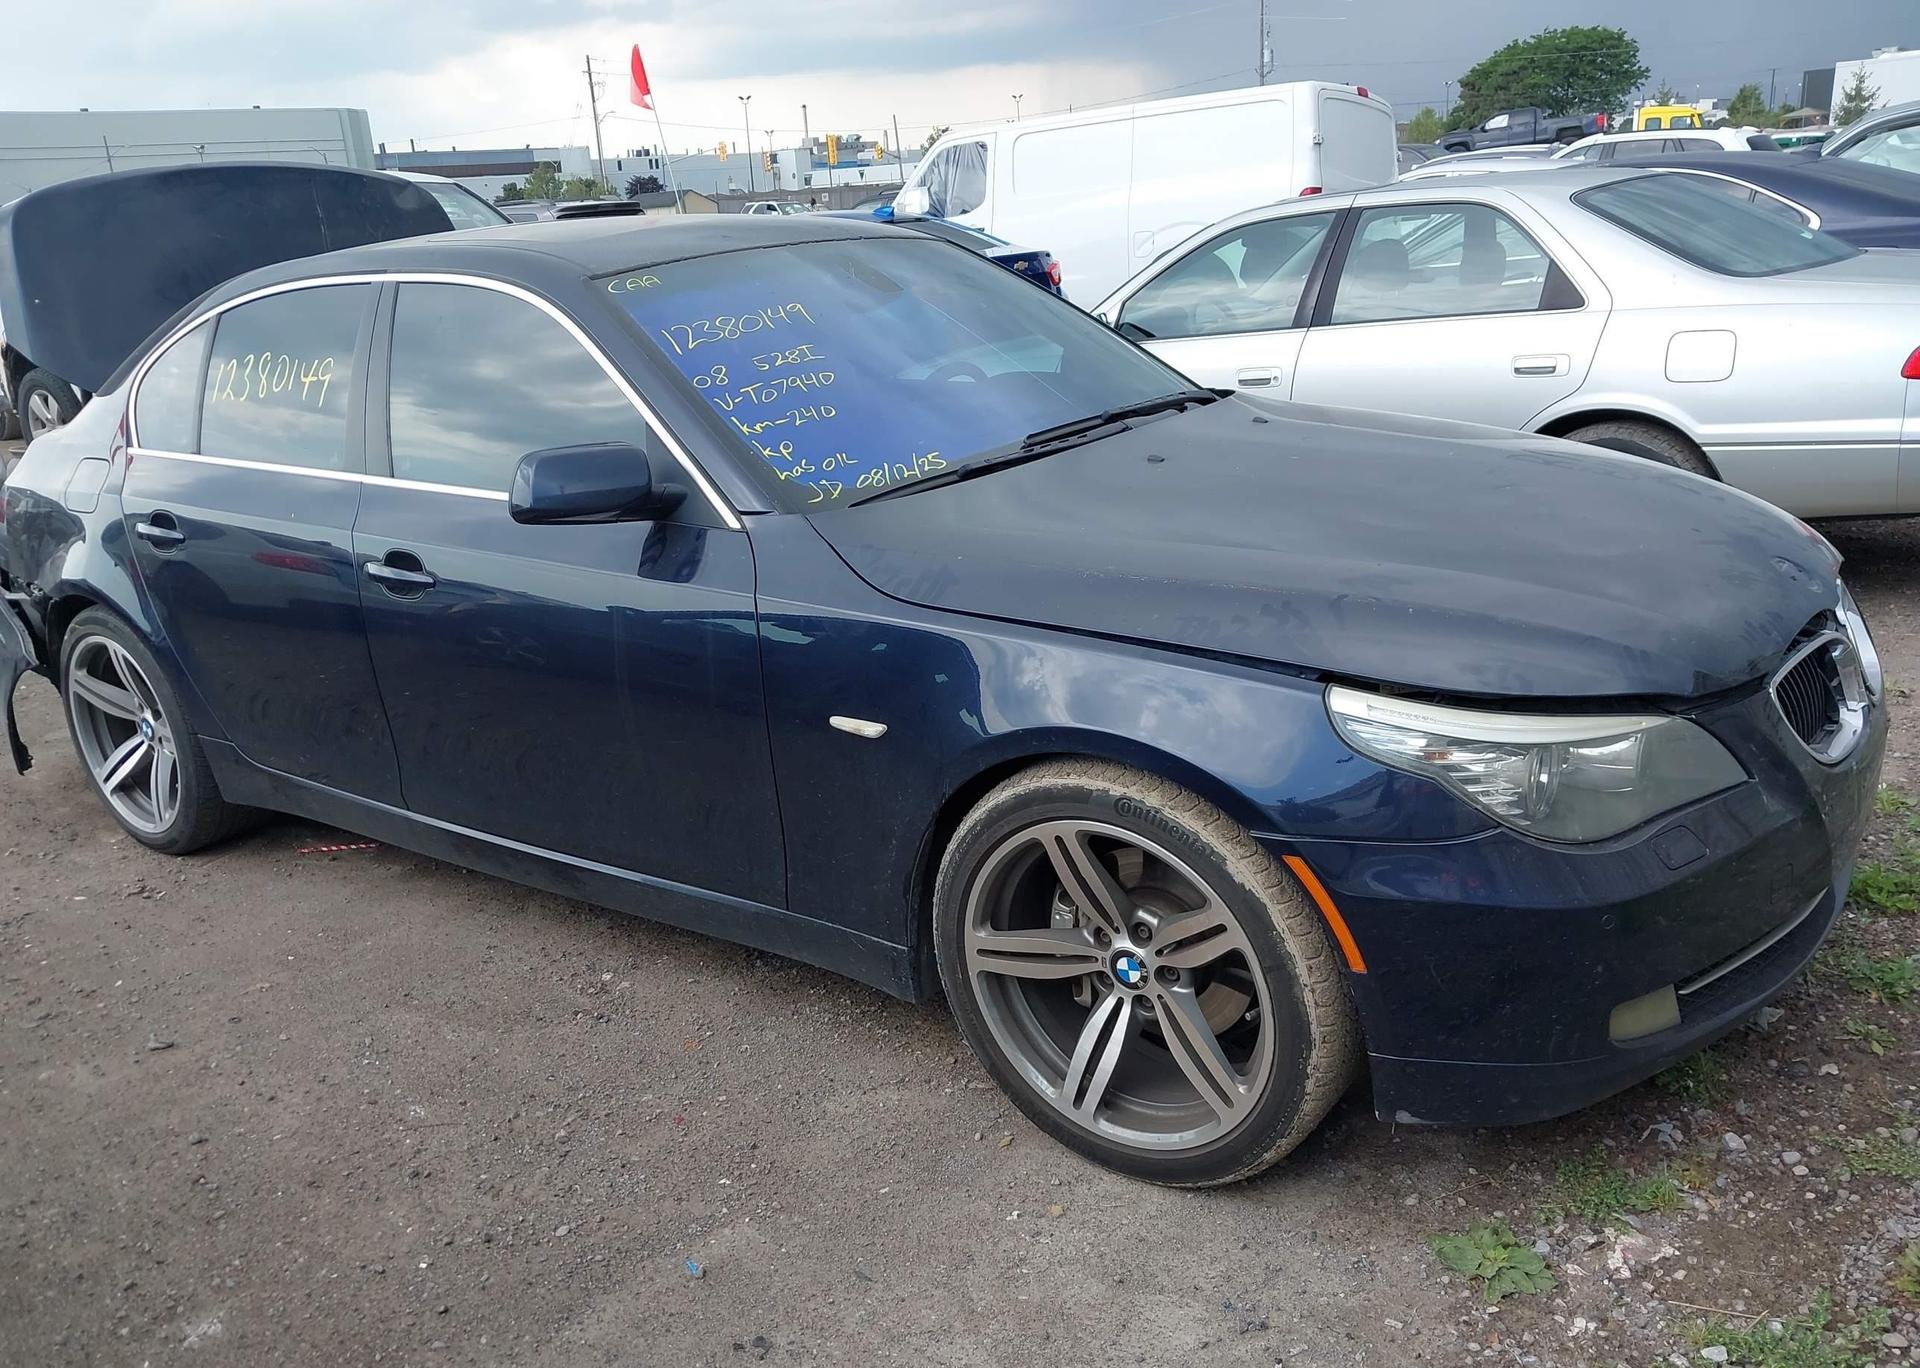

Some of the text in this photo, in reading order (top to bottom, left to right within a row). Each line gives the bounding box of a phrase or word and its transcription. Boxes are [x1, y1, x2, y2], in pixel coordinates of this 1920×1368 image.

[607, 275, 661, 294] CAA
[661, 303, 815, 355] 12380149
[213, 351, 334, 408] 12380149
[693, 365, 729, 389] 08
[856, 452, 947, 489] 08/12/25
[1114, 797, 1217, 860] Continenta
